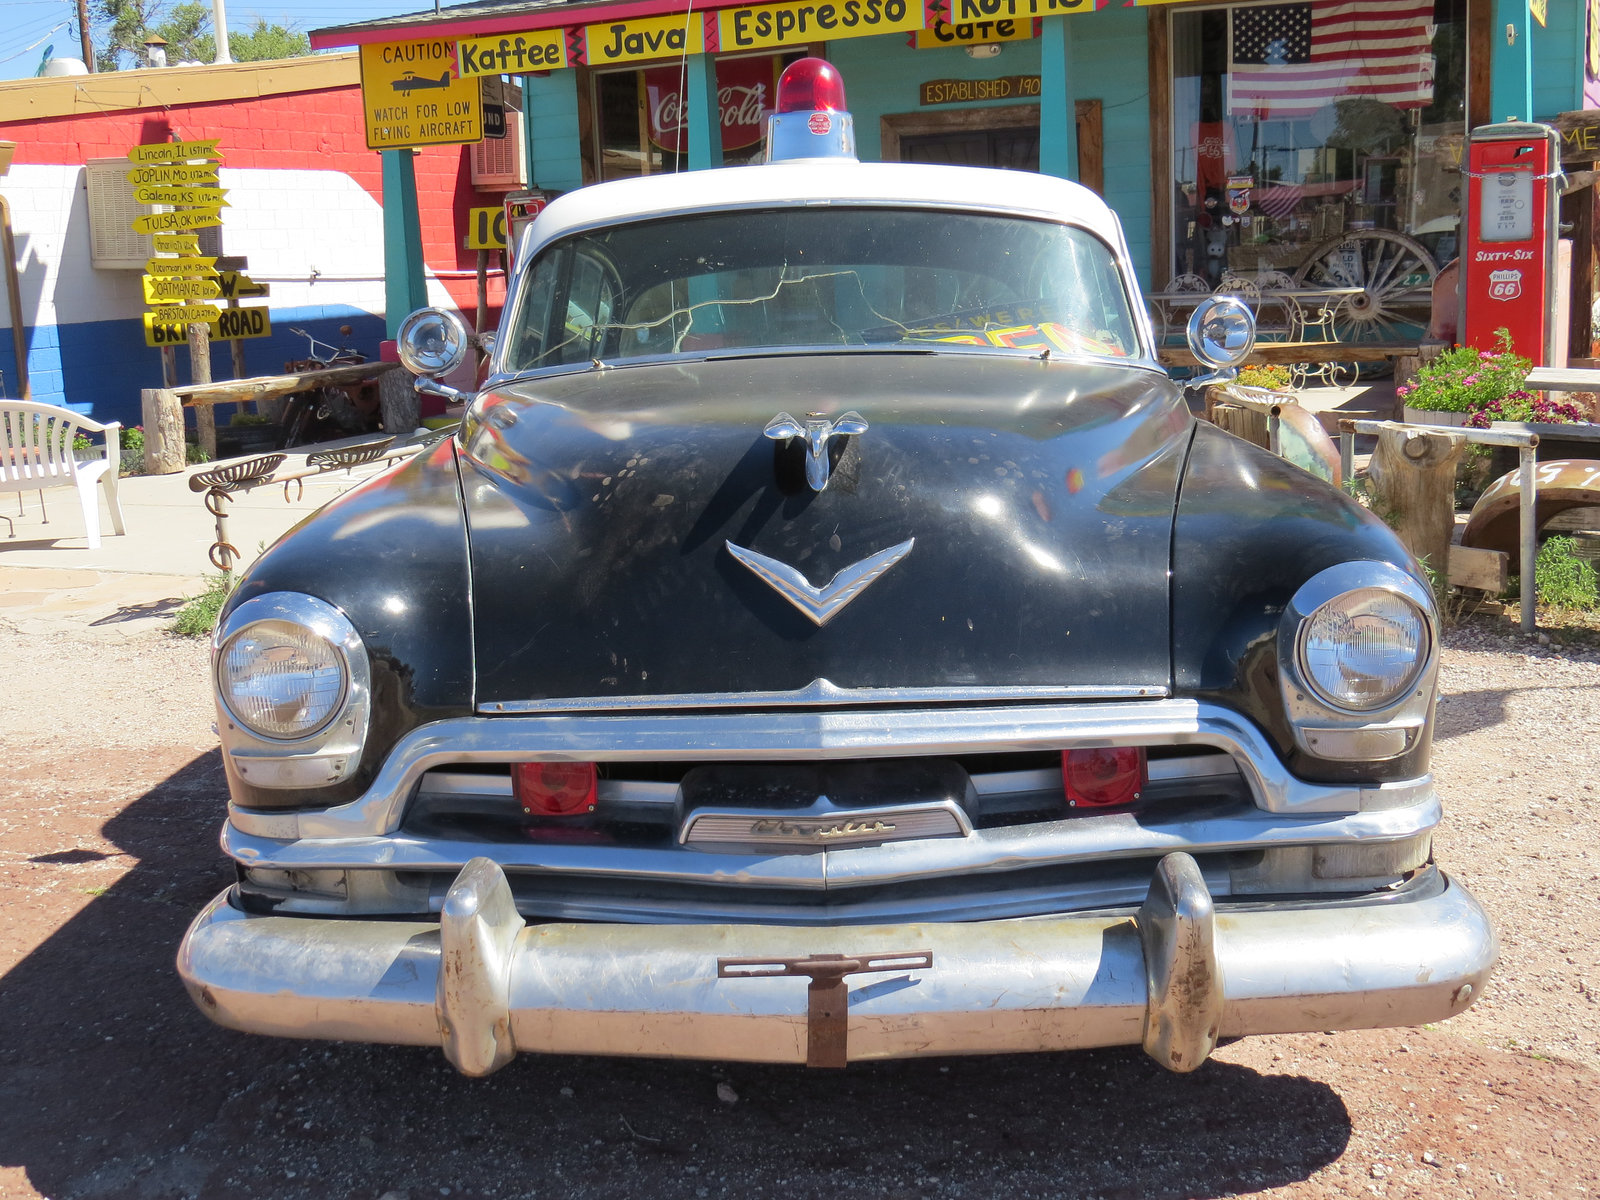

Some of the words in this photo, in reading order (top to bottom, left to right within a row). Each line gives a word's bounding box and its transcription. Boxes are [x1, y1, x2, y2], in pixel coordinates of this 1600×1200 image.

[733, 0, 906, 46] Espresso
[603, 24, 686, 57] Java
[382, 41, 454, 64] CAUTION
[461, 37, 560, 73] Kaffee
[926, 79, 1011, 102] ESTABLISHED
[374, 106, 408, 122] WATCH
[416, 104, 438, 118] FOR
[447, 101, 470, 116] LOW
[374, 125, 410, 141] FLYING
[419, 120, 473, 137] AIRCRAFT
[1475, 249, 1534, 262] SIXTY-SIX
[1493, 283, 1516, 296] 66
[220, 309, 264, 337] ROAD
